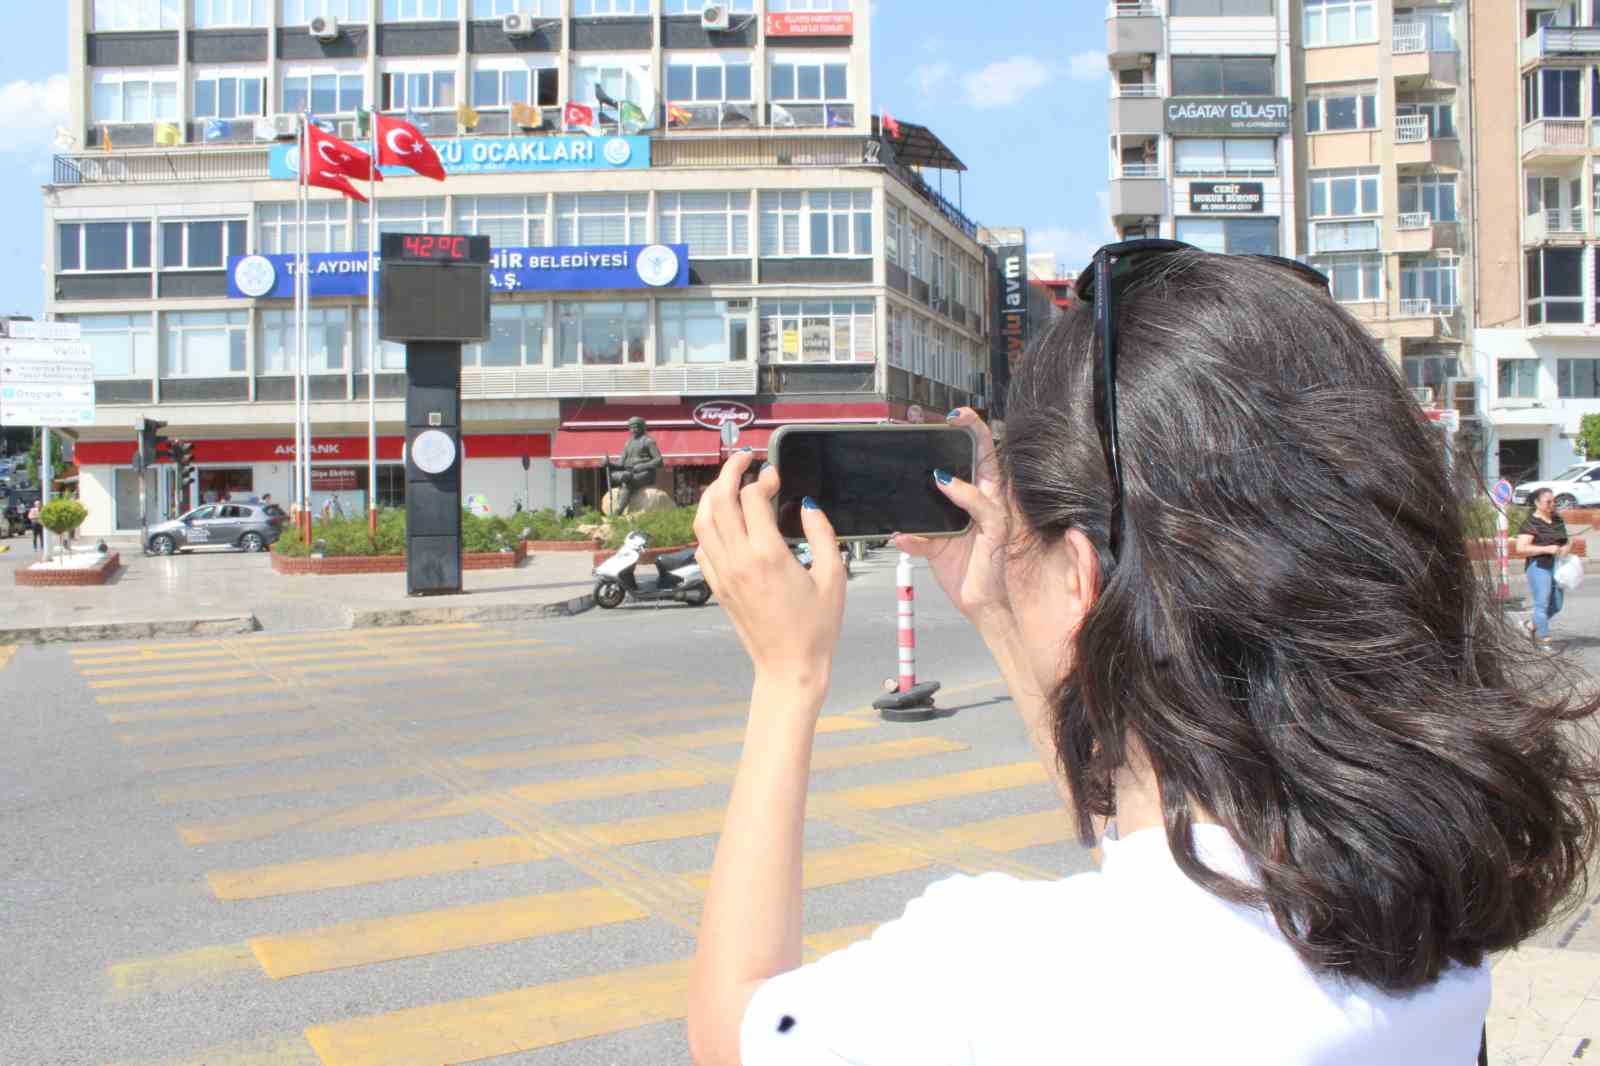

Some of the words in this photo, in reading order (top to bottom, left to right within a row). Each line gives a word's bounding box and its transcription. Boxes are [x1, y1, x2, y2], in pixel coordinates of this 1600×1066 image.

[1168, 103, 1228, 120] ÇAĞATAY
[1230, 101, 1287, 120] GÜLAŞTI
[431, 139, 462, 163] KÜ
[472, 140, 593, 162] OCAKLARI
[317, 260, 367, 273] AYDIN
[529, 250, 629, 269] BELEDİYESİ
[275, 443, 340, 455] AKANK
